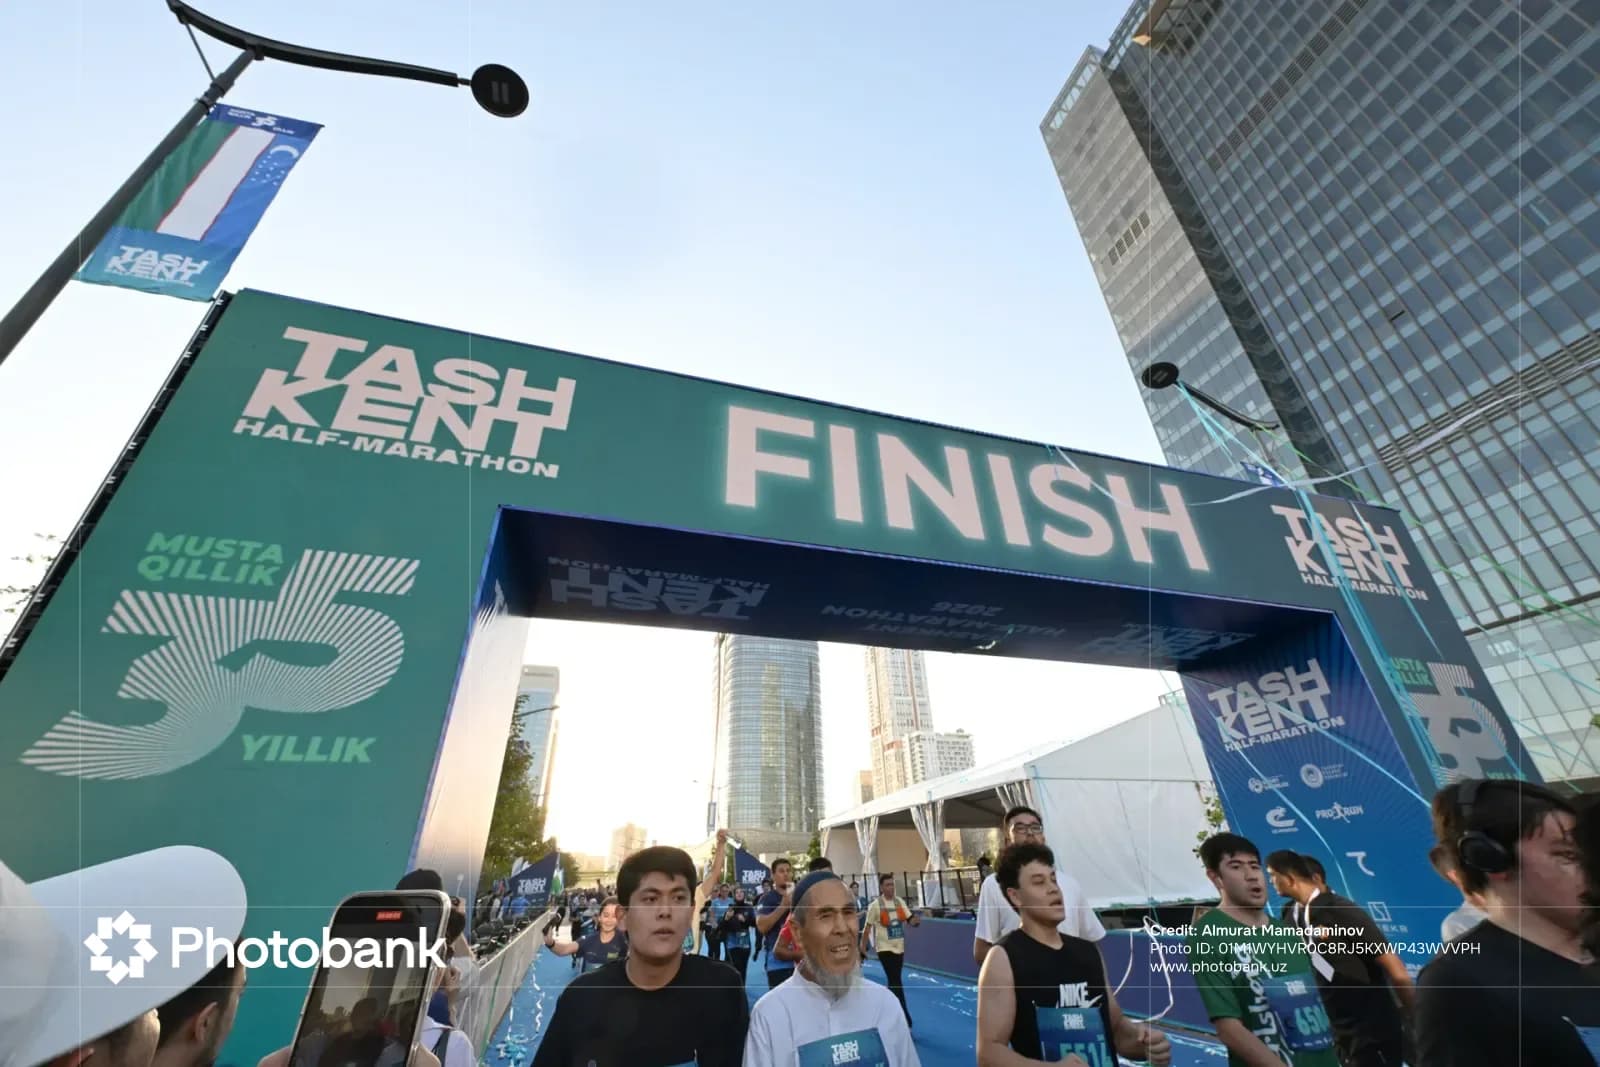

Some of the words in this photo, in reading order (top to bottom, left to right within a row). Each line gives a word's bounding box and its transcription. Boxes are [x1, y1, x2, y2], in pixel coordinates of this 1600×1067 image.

[106, 255, 198, 284] KENT
[120, 245, 209, 274] TASH
[283, 326, 577, 431] TASH
[242, 368, 563, 459] KENT
[233, 418, 560, 478] HALF-MARATHON
[725, 405, 1211, 572] FINISH
[146, 532, 285, 565] MUSTA
[1270, 504, 1410, 565] TASH
[137, 555, 282, 587] QILLIK
[548, 556, 770, 590] HALF-MARATHON
[1284, 536, 1414, 588] KENT
[550, 578, 750, 621] TASH
[567, 567, 769, 608] KENT
[931, 601, 1004, 617] 2026
[19, 548, 421, 781] 35
[1208, 658, 1331, 718] TASH
[1216, 692, 1330, 744] KENT
[1224, 715, 1346, 752] HALF-MARATHON
[241, 734, 377, 763] YILLIK
[1060, 981, 1089, 1008] NIKE
[831, 1040, 859, 1054] TASH
